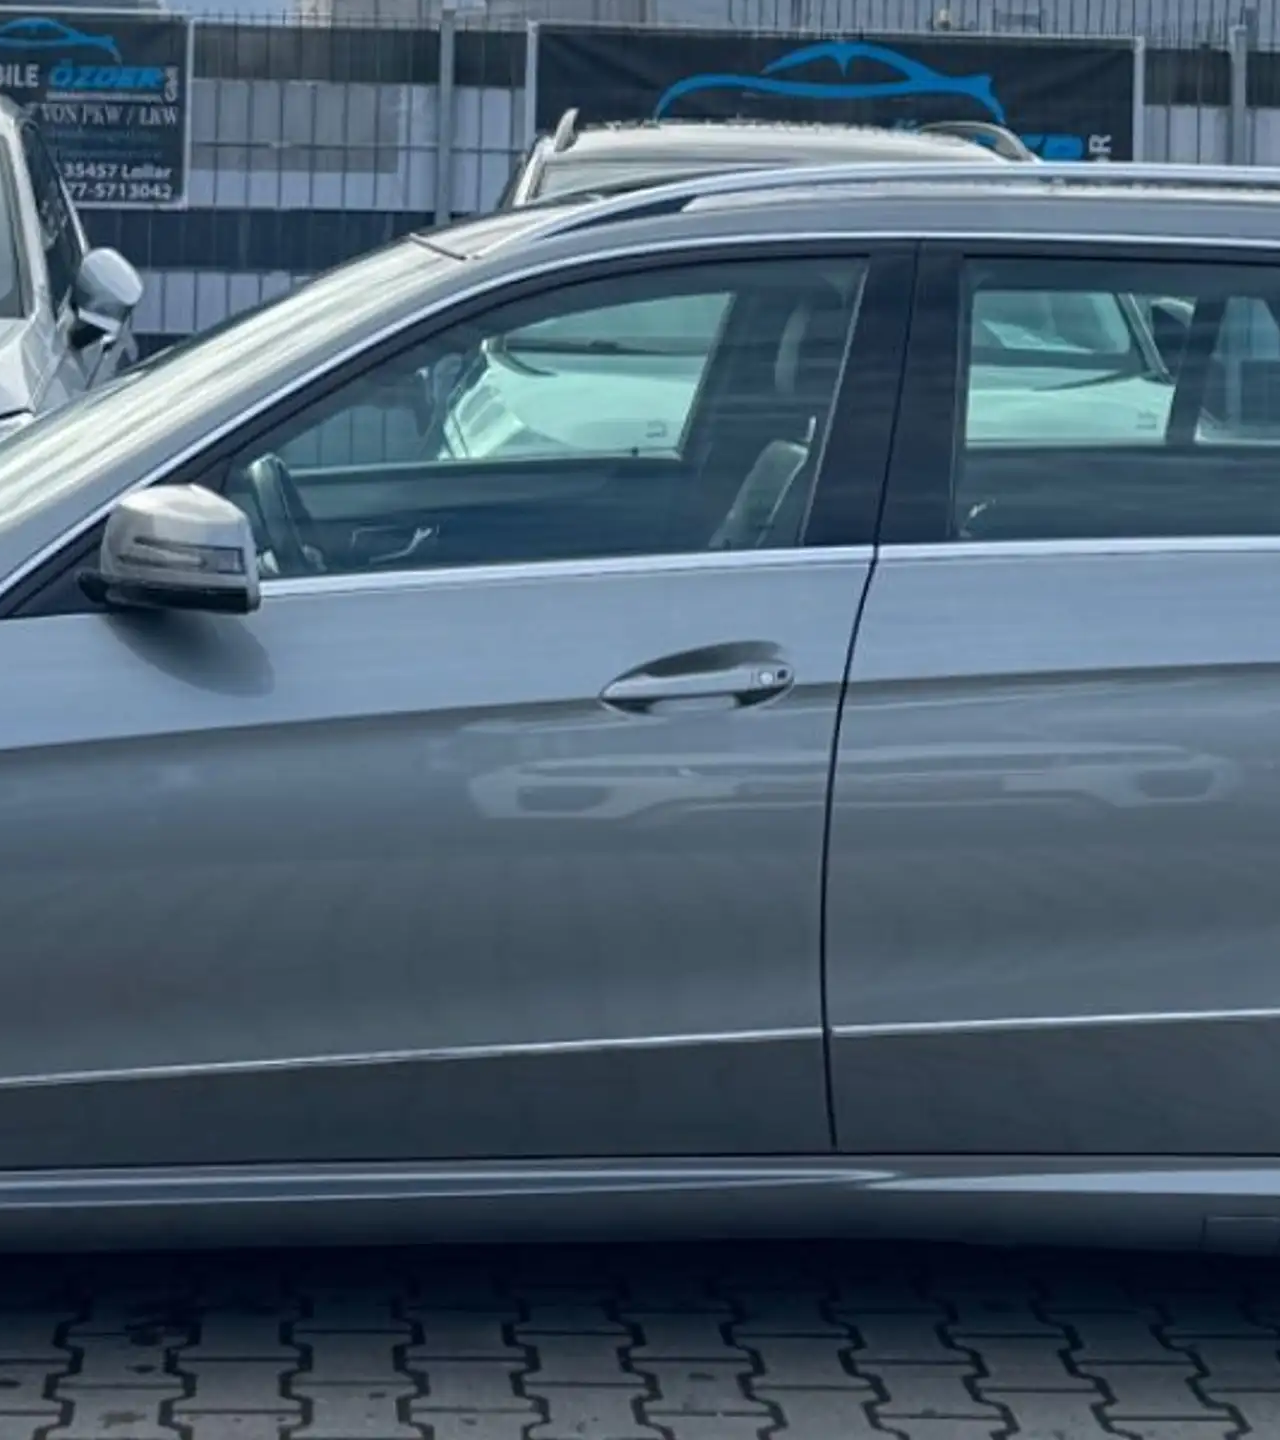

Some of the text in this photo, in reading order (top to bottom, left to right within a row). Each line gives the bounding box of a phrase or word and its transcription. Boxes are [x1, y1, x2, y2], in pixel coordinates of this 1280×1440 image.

[82, 104, 121, 125] PKW
[139, 106, 178, 126] LKW
[63, 162, 118, 179] 35457
